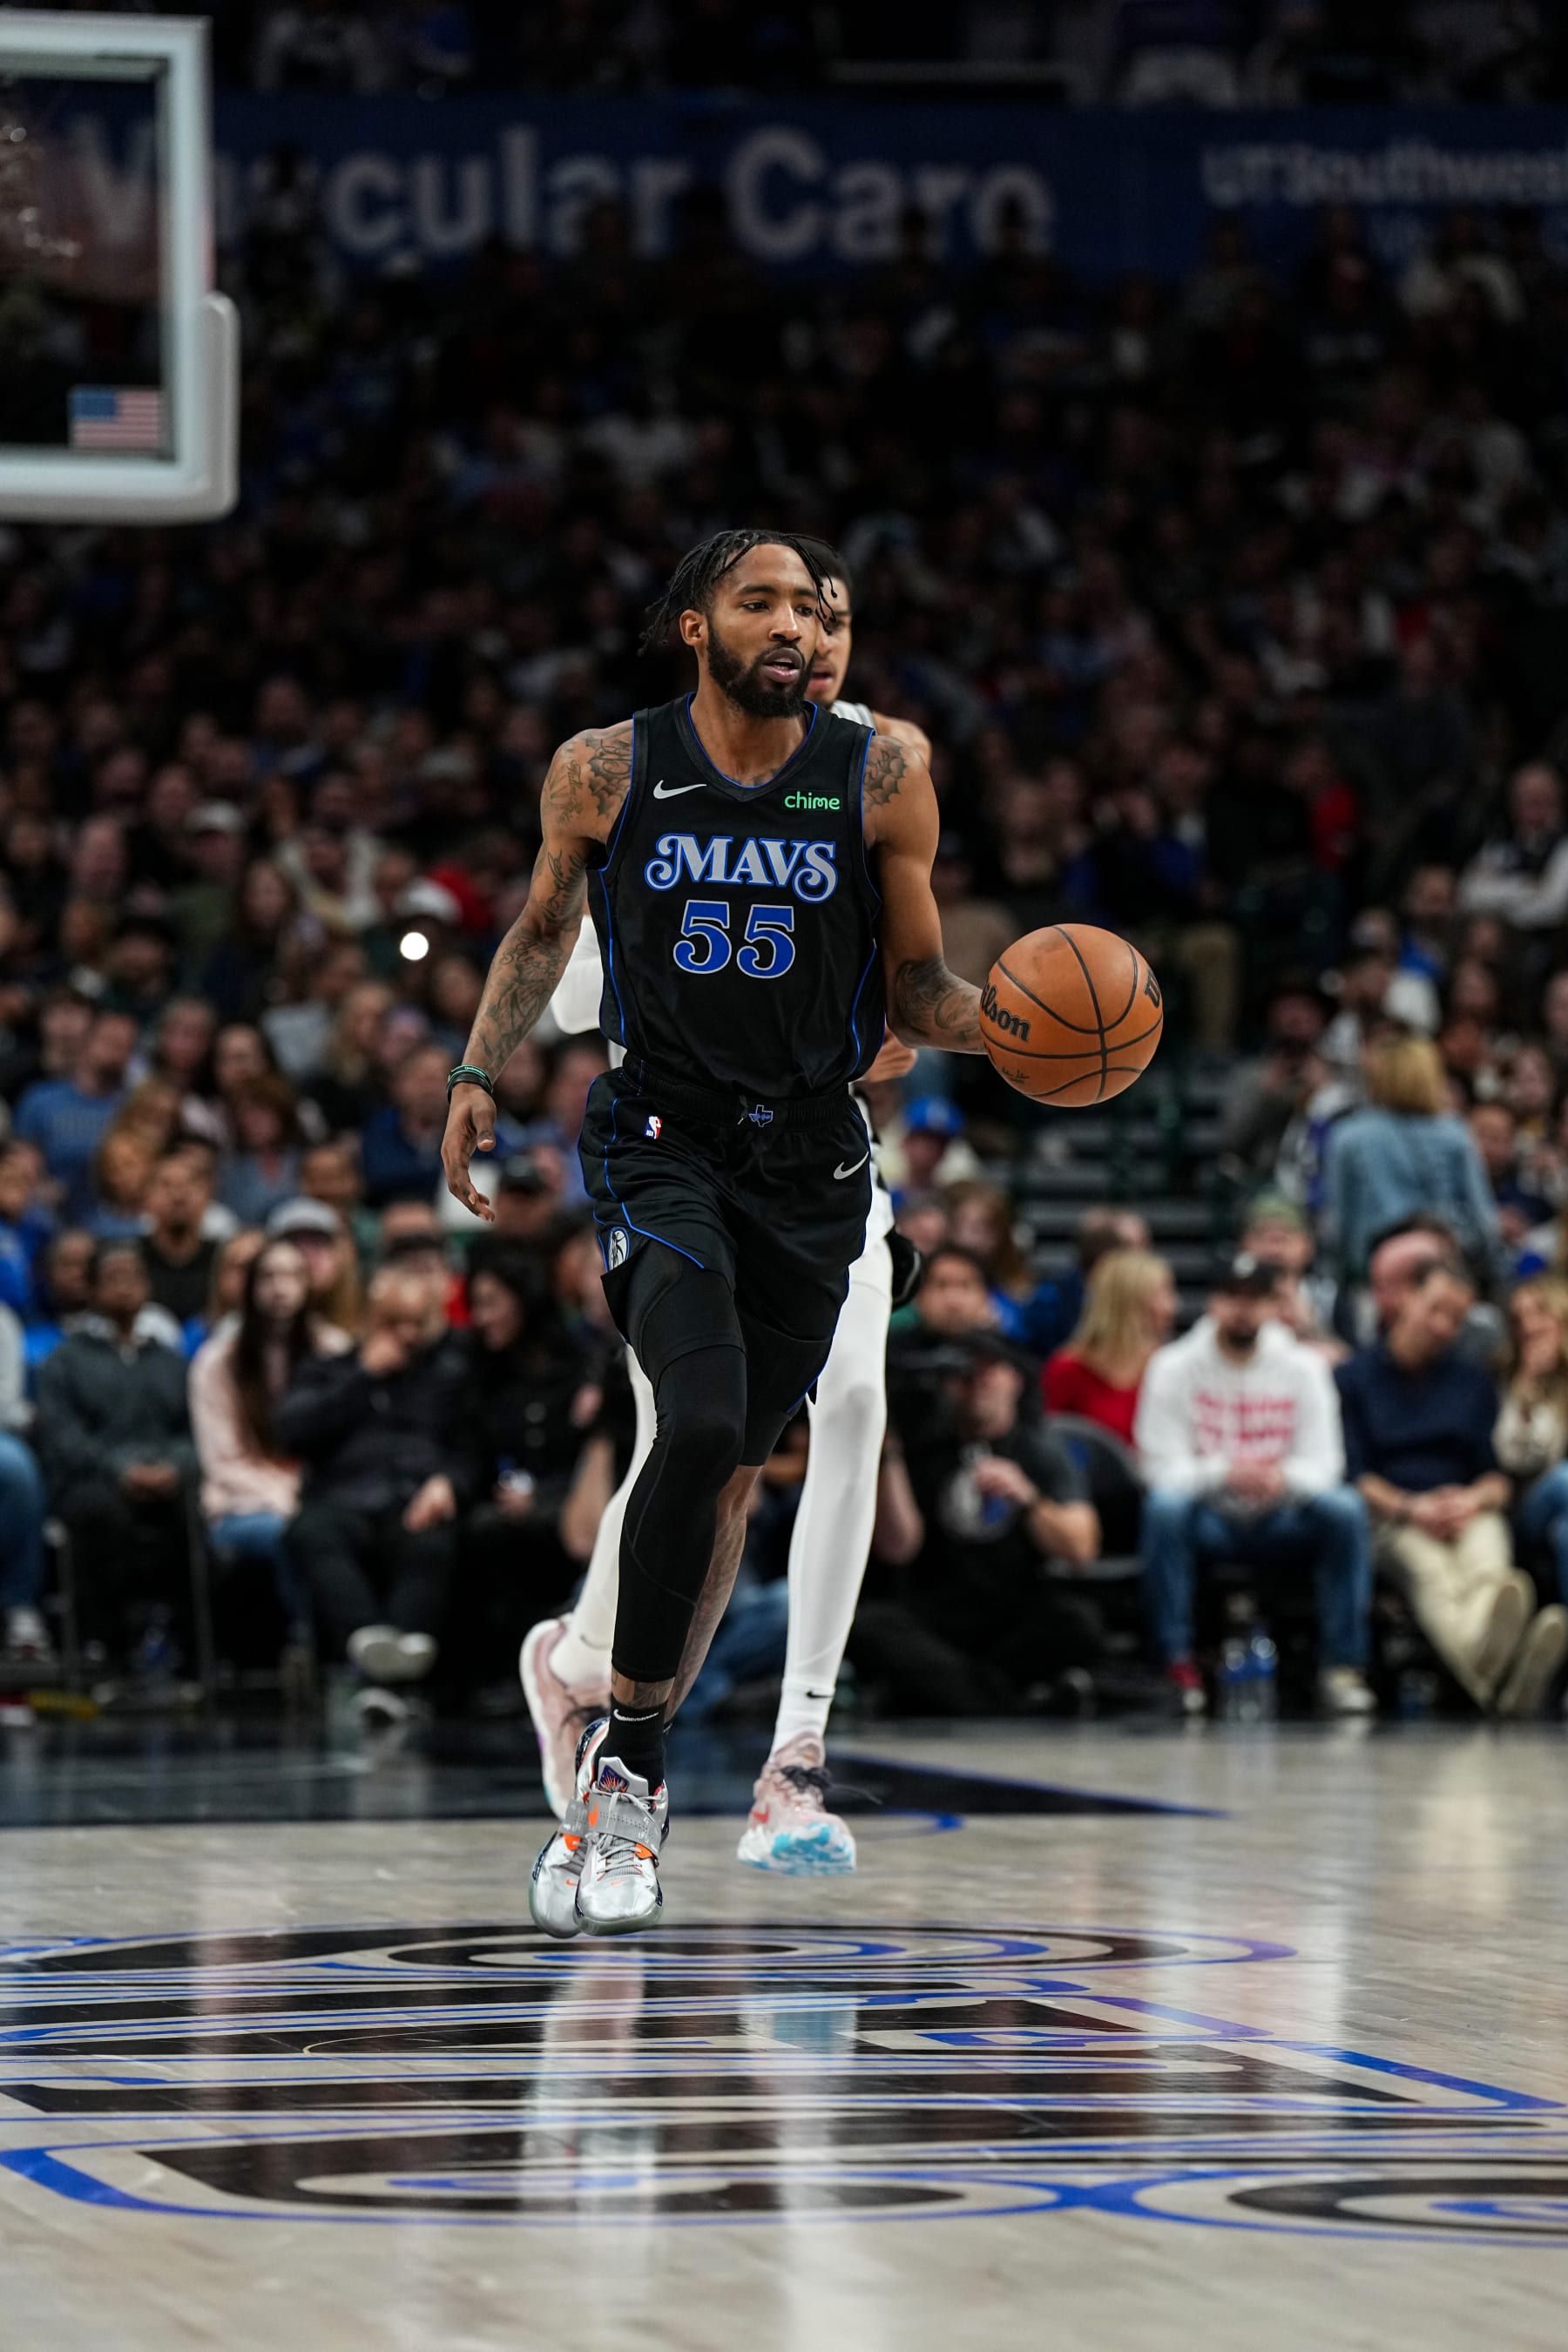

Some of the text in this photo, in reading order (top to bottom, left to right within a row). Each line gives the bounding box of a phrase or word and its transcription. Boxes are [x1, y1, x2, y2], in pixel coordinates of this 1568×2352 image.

[64, 116, 695, 260] Vcular
[784, 791, 841, 810] chime
[644, 833, 839, 903] MAVS
[672, 899, 796, 979] 55
[980, 980, 1031, 1043] ilson
